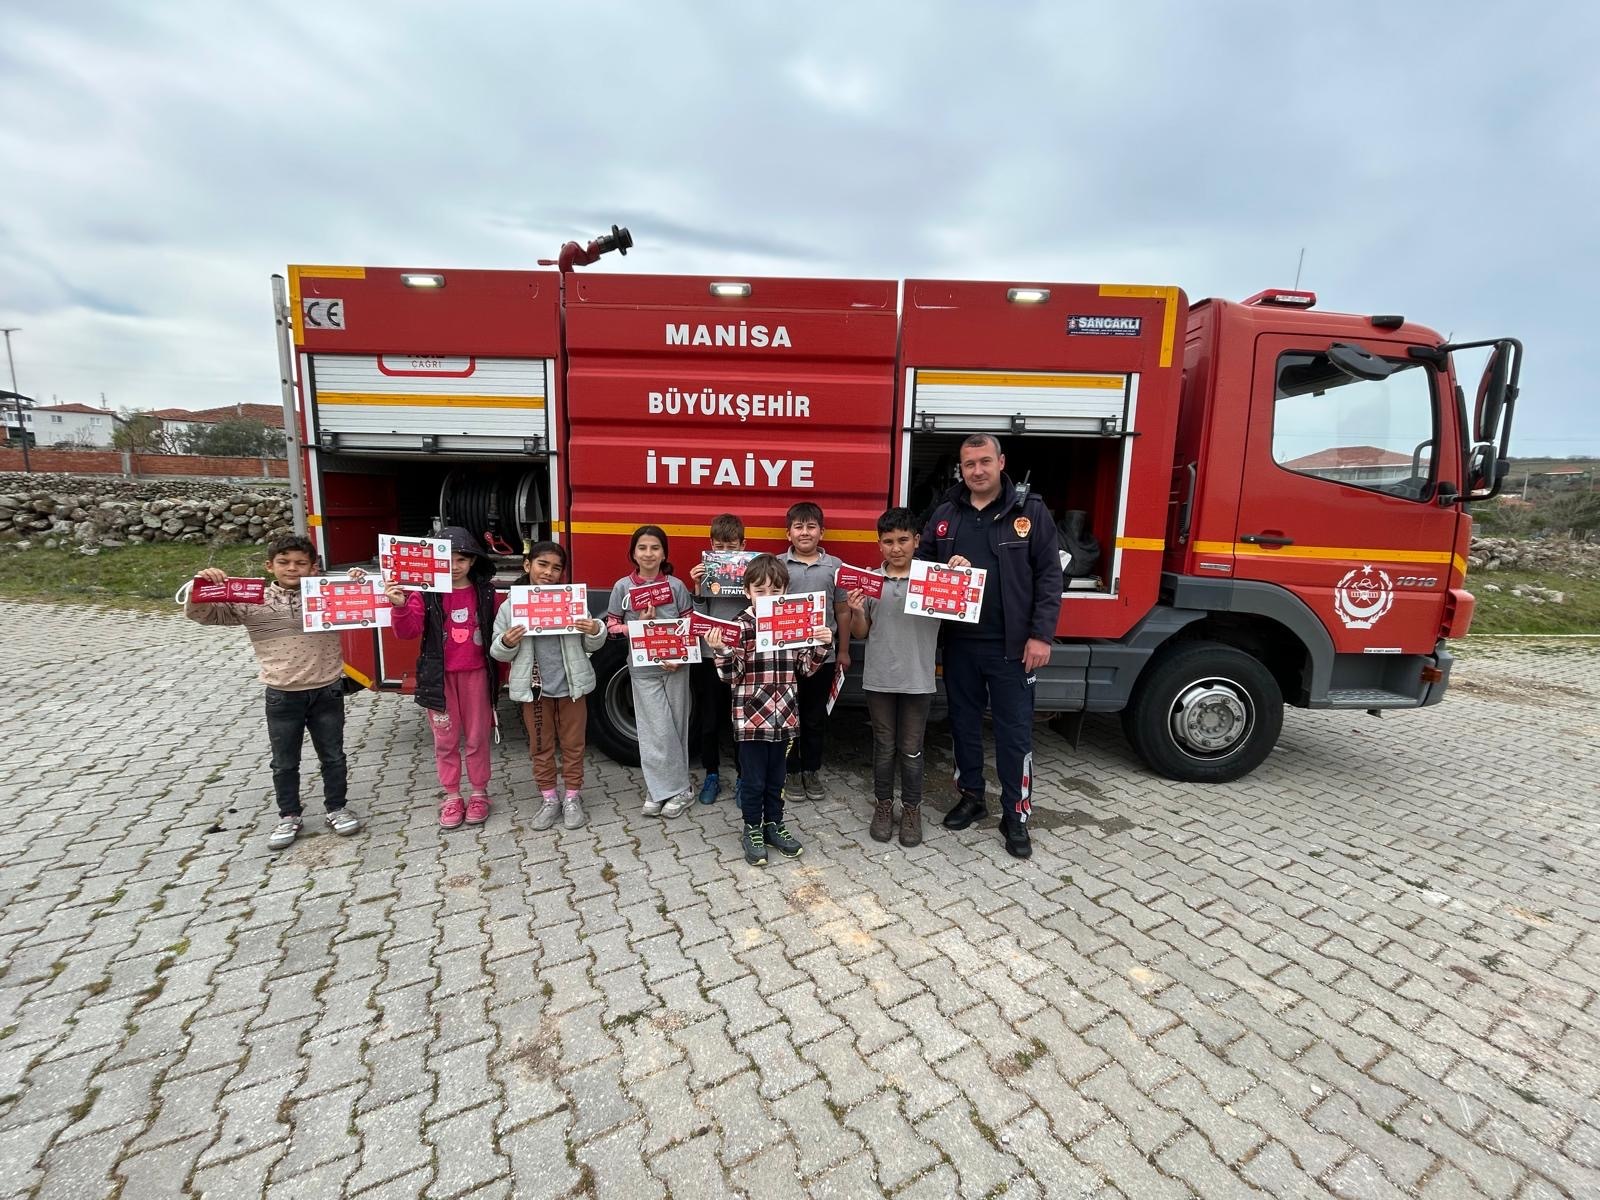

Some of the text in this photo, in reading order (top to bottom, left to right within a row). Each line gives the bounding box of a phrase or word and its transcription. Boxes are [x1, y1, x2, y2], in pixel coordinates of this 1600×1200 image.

[306, 301, 341, 327] CE
[1078, 317, 1140, 329] SANCAKLI
[665, 320, 792, 348] MANİSA
[648, 387, 810, 422] BÜYÜKŞEHİR
[646, 449, 815, 488] İTFAİYE
